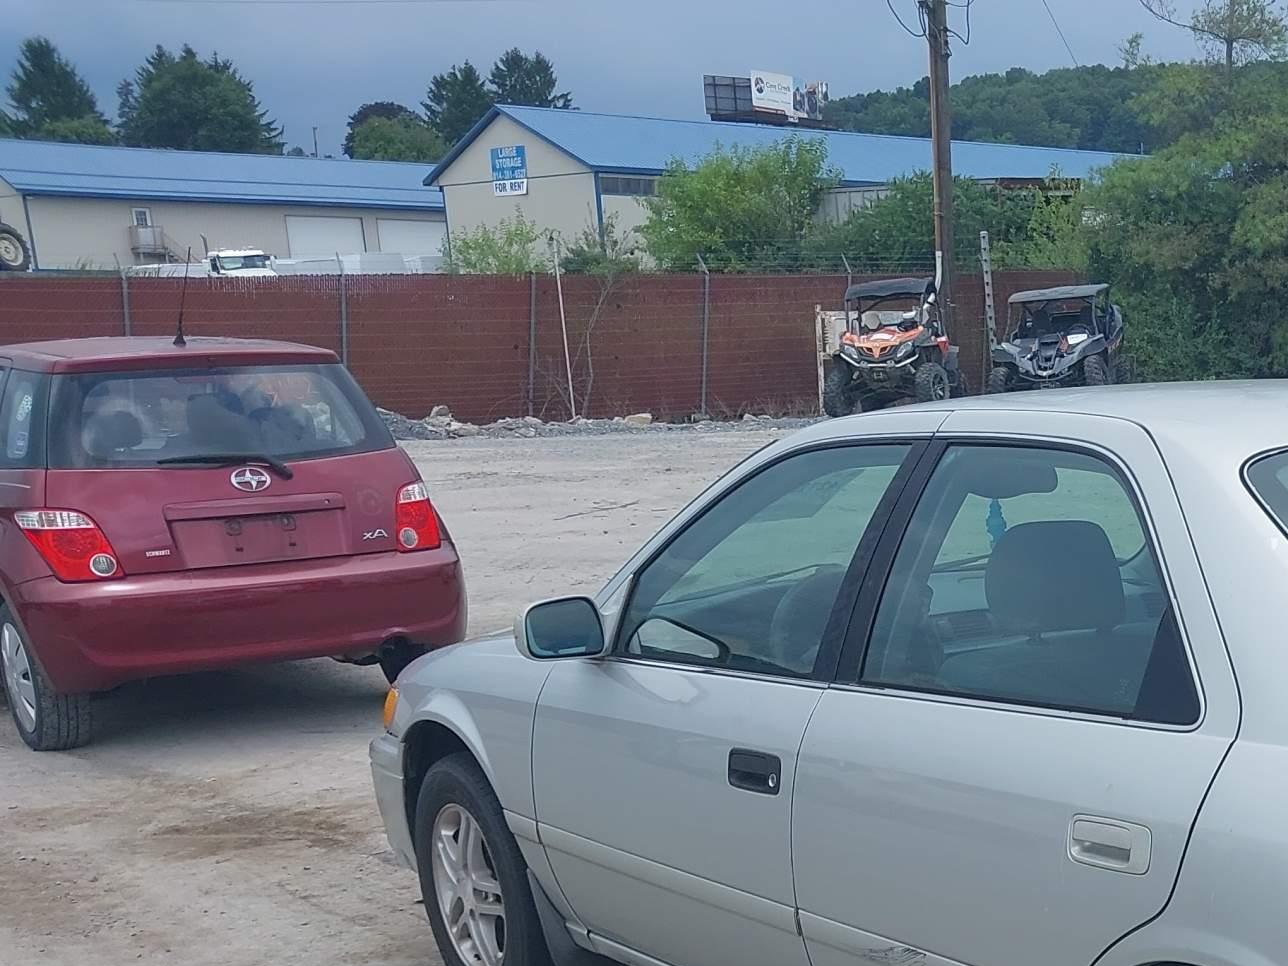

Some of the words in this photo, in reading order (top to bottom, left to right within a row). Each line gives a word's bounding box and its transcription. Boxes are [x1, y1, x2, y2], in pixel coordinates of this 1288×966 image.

[497, 147, 517, 158] LARGE
[495, 157, 523, 168] STORAGE
[495, 182, 508, 192] FOR
[510, 181, 524, 191] RENT
[362, 529, 389, 540] xA
